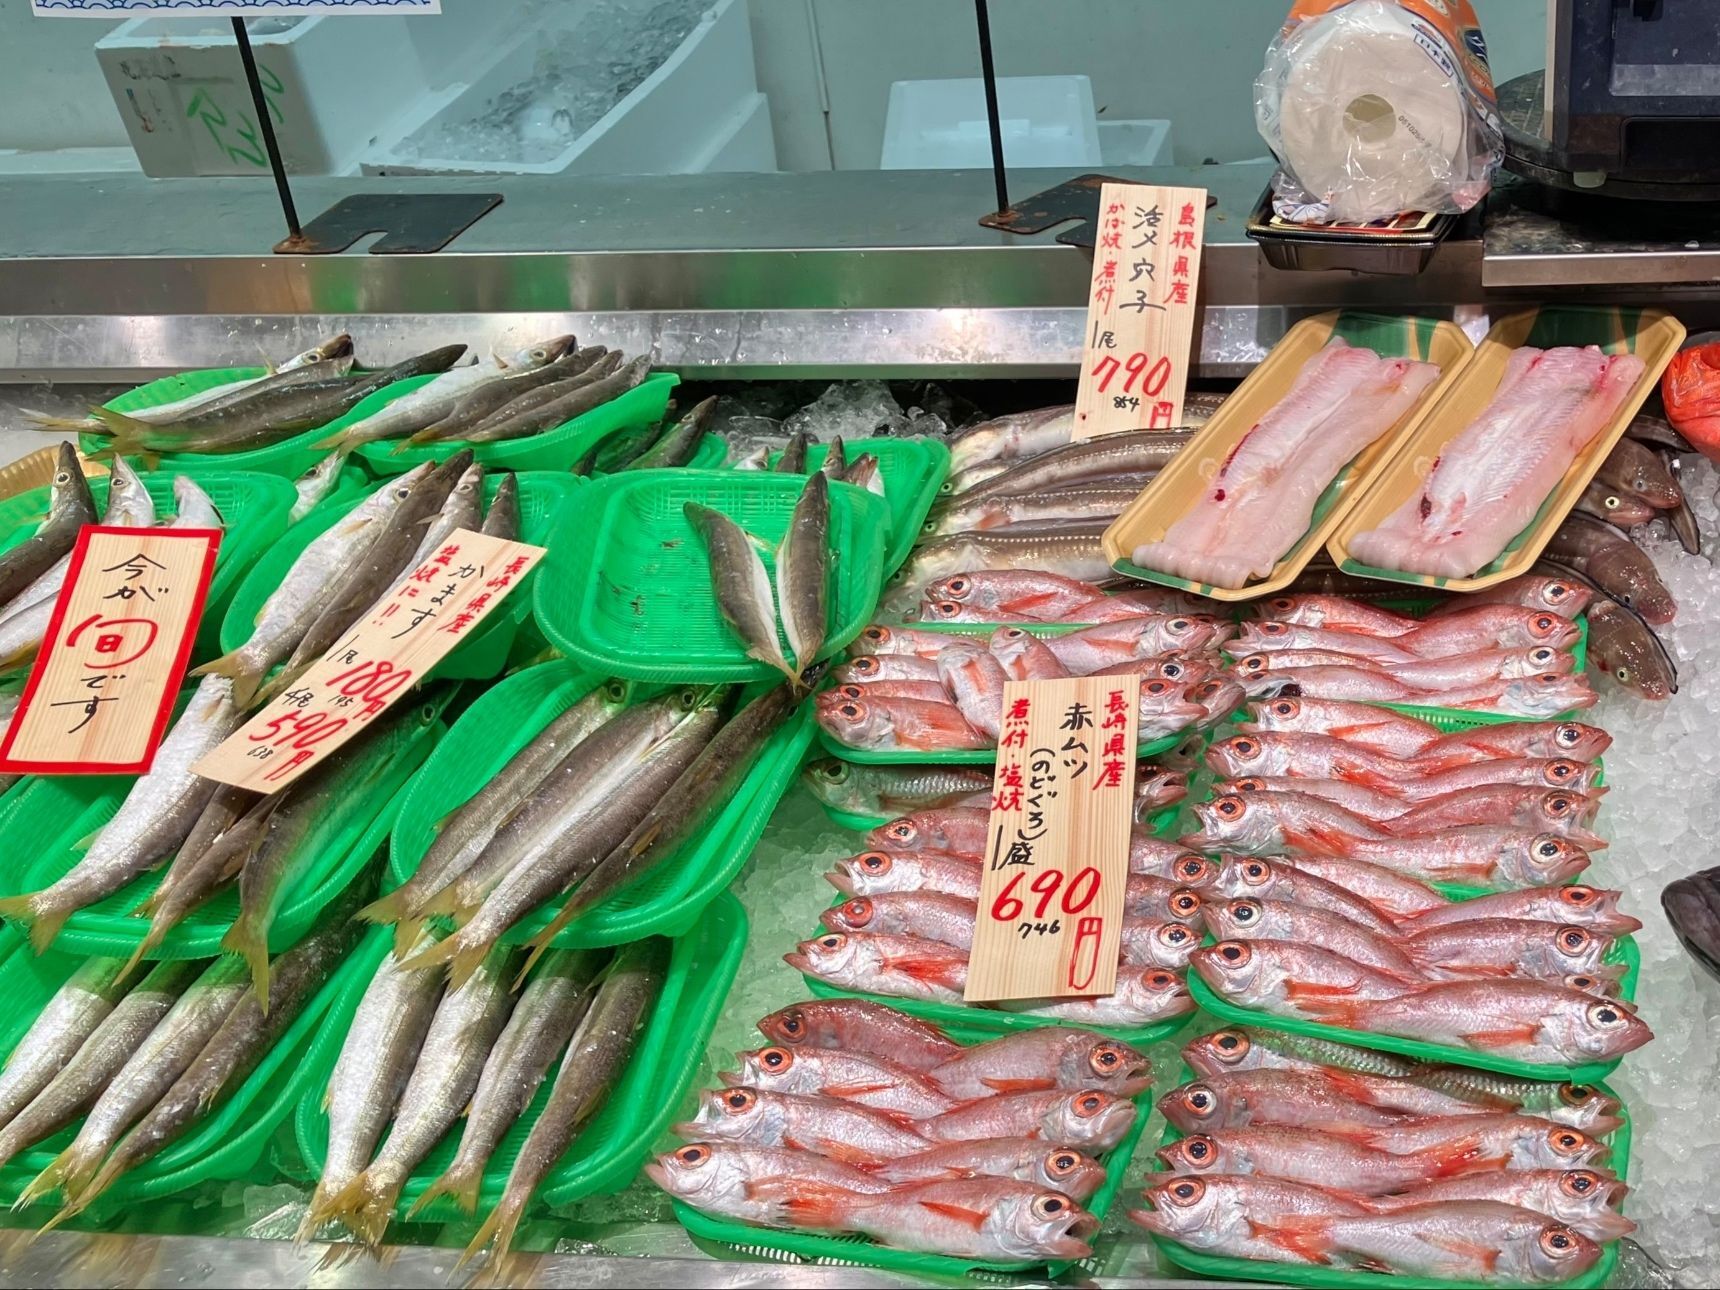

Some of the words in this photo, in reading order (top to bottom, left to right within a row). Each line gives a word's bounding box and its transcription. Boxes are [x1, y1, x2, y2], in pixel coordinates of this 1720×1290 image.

[1163, 202, 1197, 304] 島根県産
[1092, 352, 1172, 397] 790
[391, 563, 484, 639] かます
[437, 556, 530, 634] 長崎県産
[325, 660, 412, 703] 180
[248, 709, 348, 750] 590
[991, 698, 1031, 812] 煮付・塩焼
[1060, 702, 1093, 779] 赤ムツ
[1092, 689, 1129, 790] 長崎県産
[1018, 747, 1058, 840] (のどぐろ)
[991, 866, 1102, 922] 690
[1068, 916, 1103, 990] 円
[1018, 919, 1061, 939] 746
